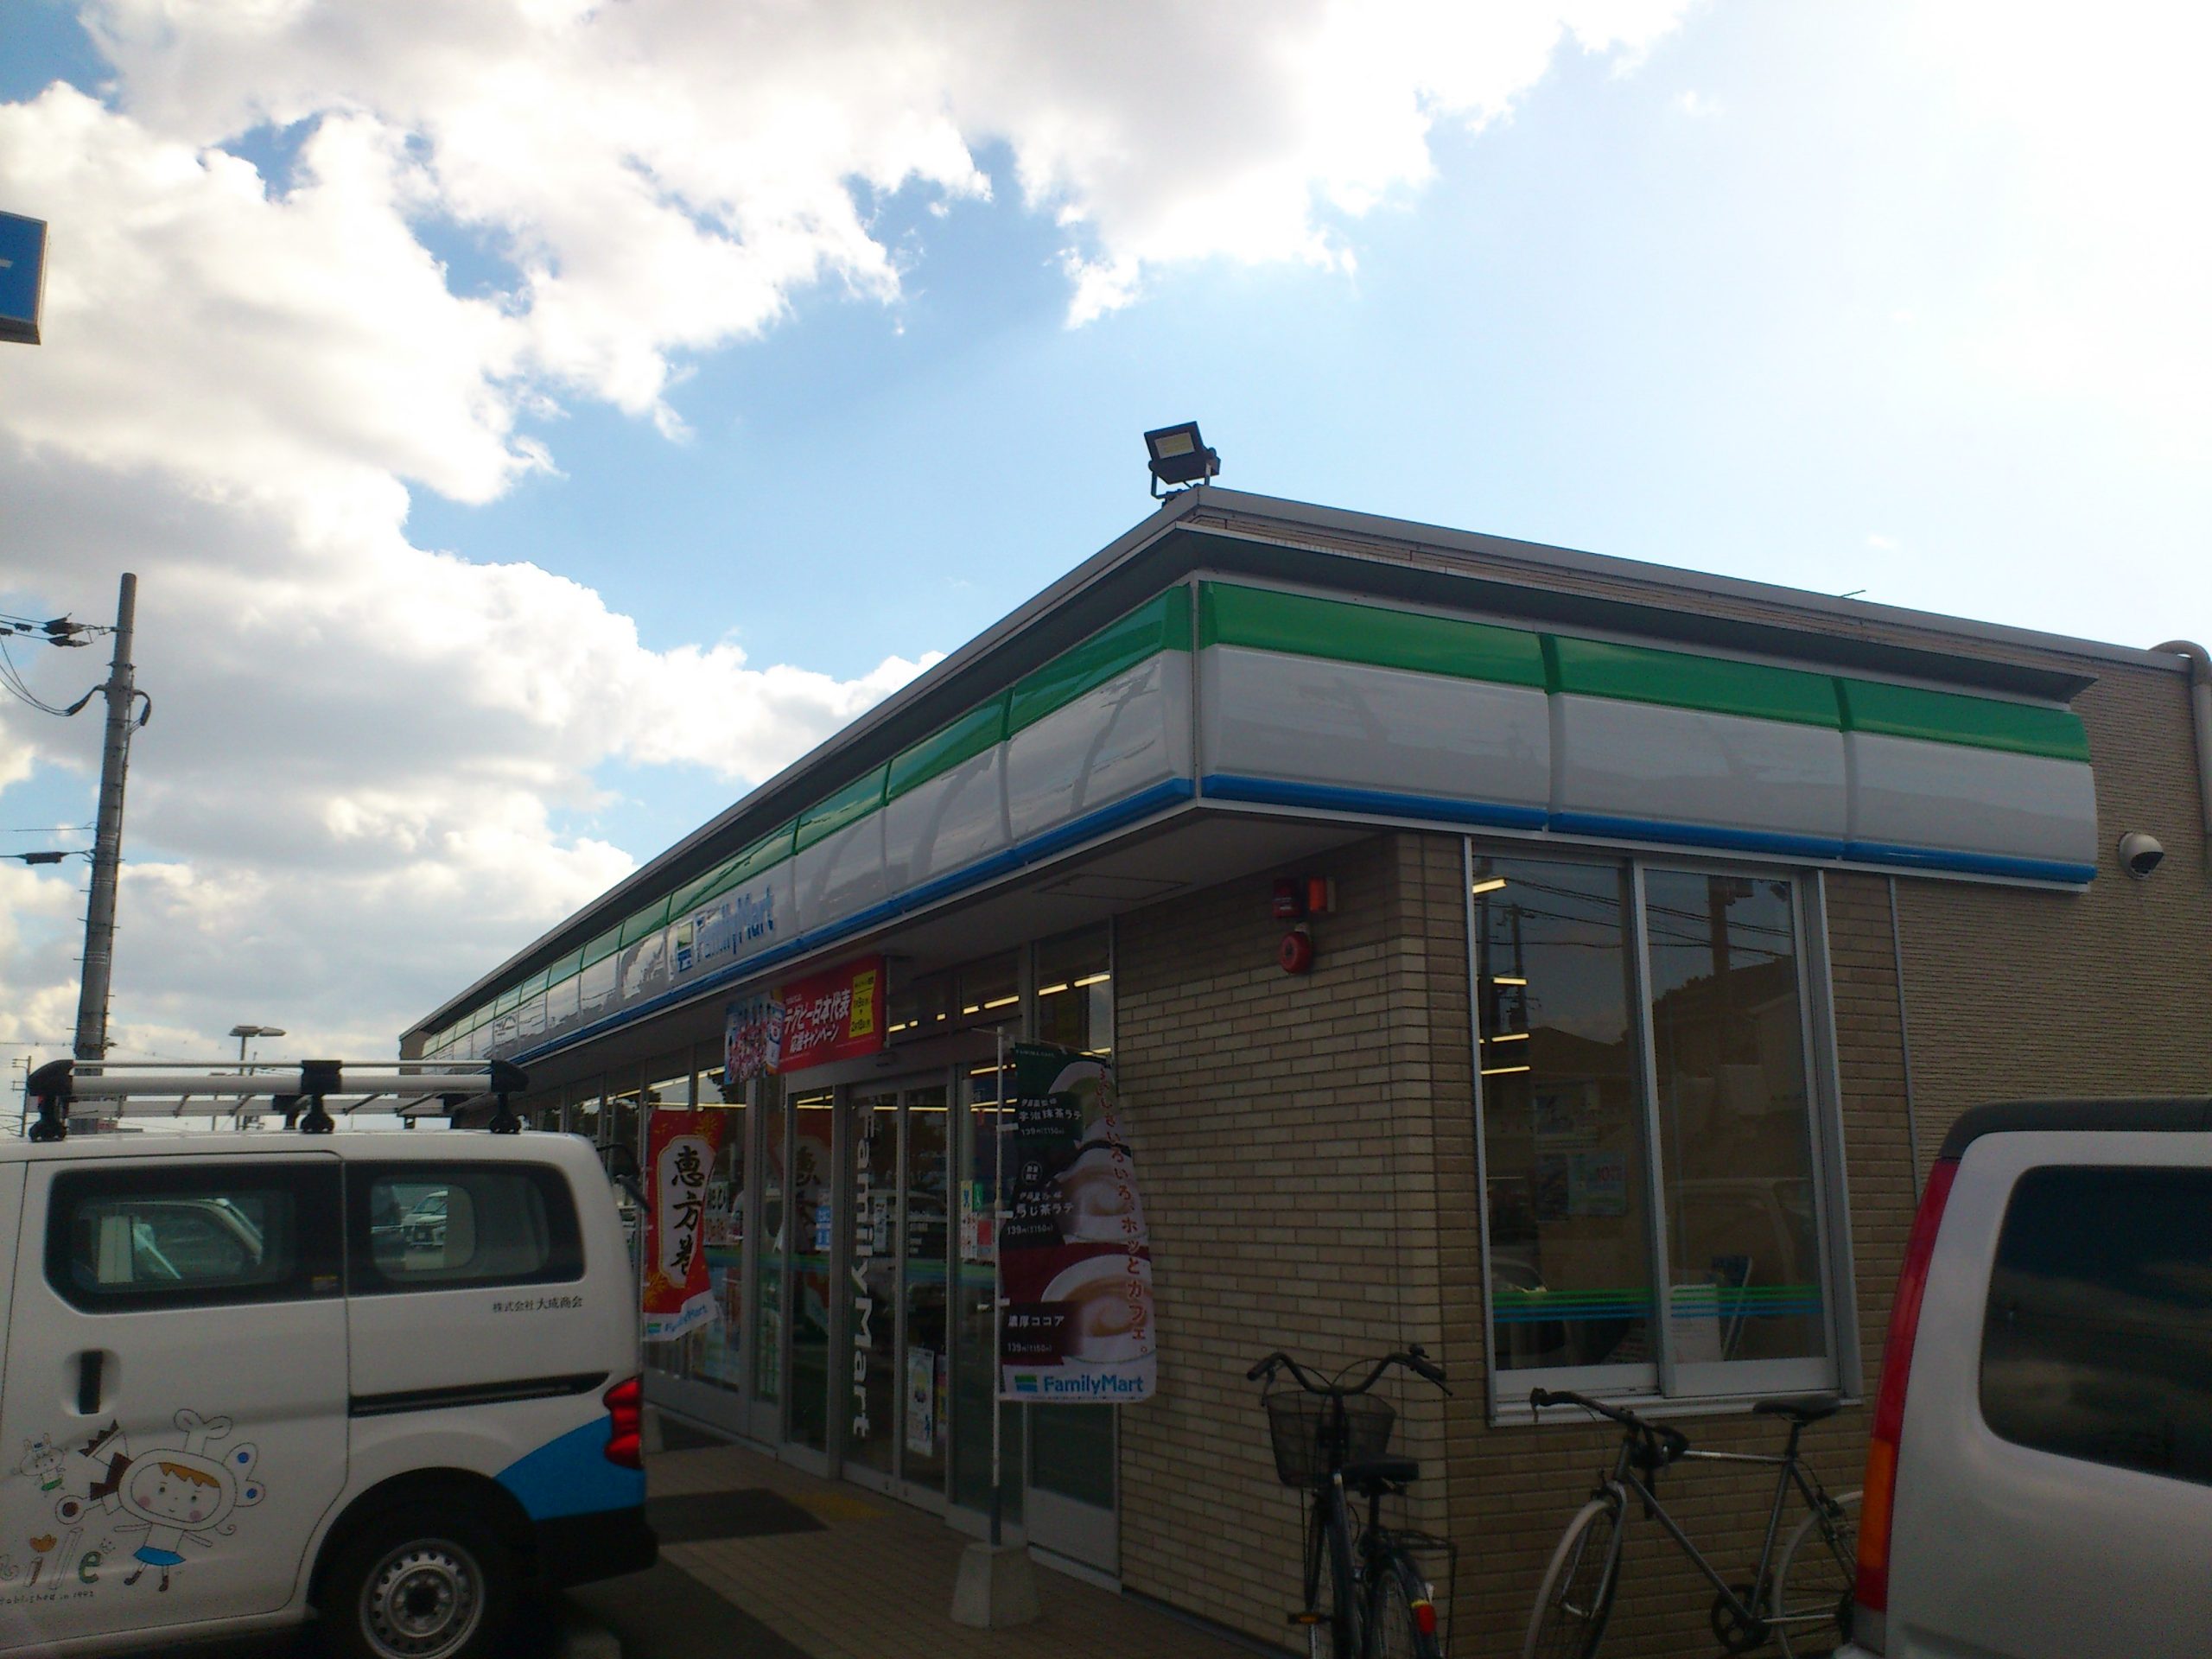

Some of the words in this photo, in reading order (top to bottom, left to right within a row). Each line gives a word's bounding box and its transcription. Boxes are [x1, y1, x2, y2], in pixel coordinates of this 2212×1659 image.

[695, 885, 774, 963] FamilyMart
[784, 988, 851, 1035] ラグビー日本代表
[671, 1145, 705, 1275] 恵方巻
[1044, 1374, 1144, 1395] FamilyMart
